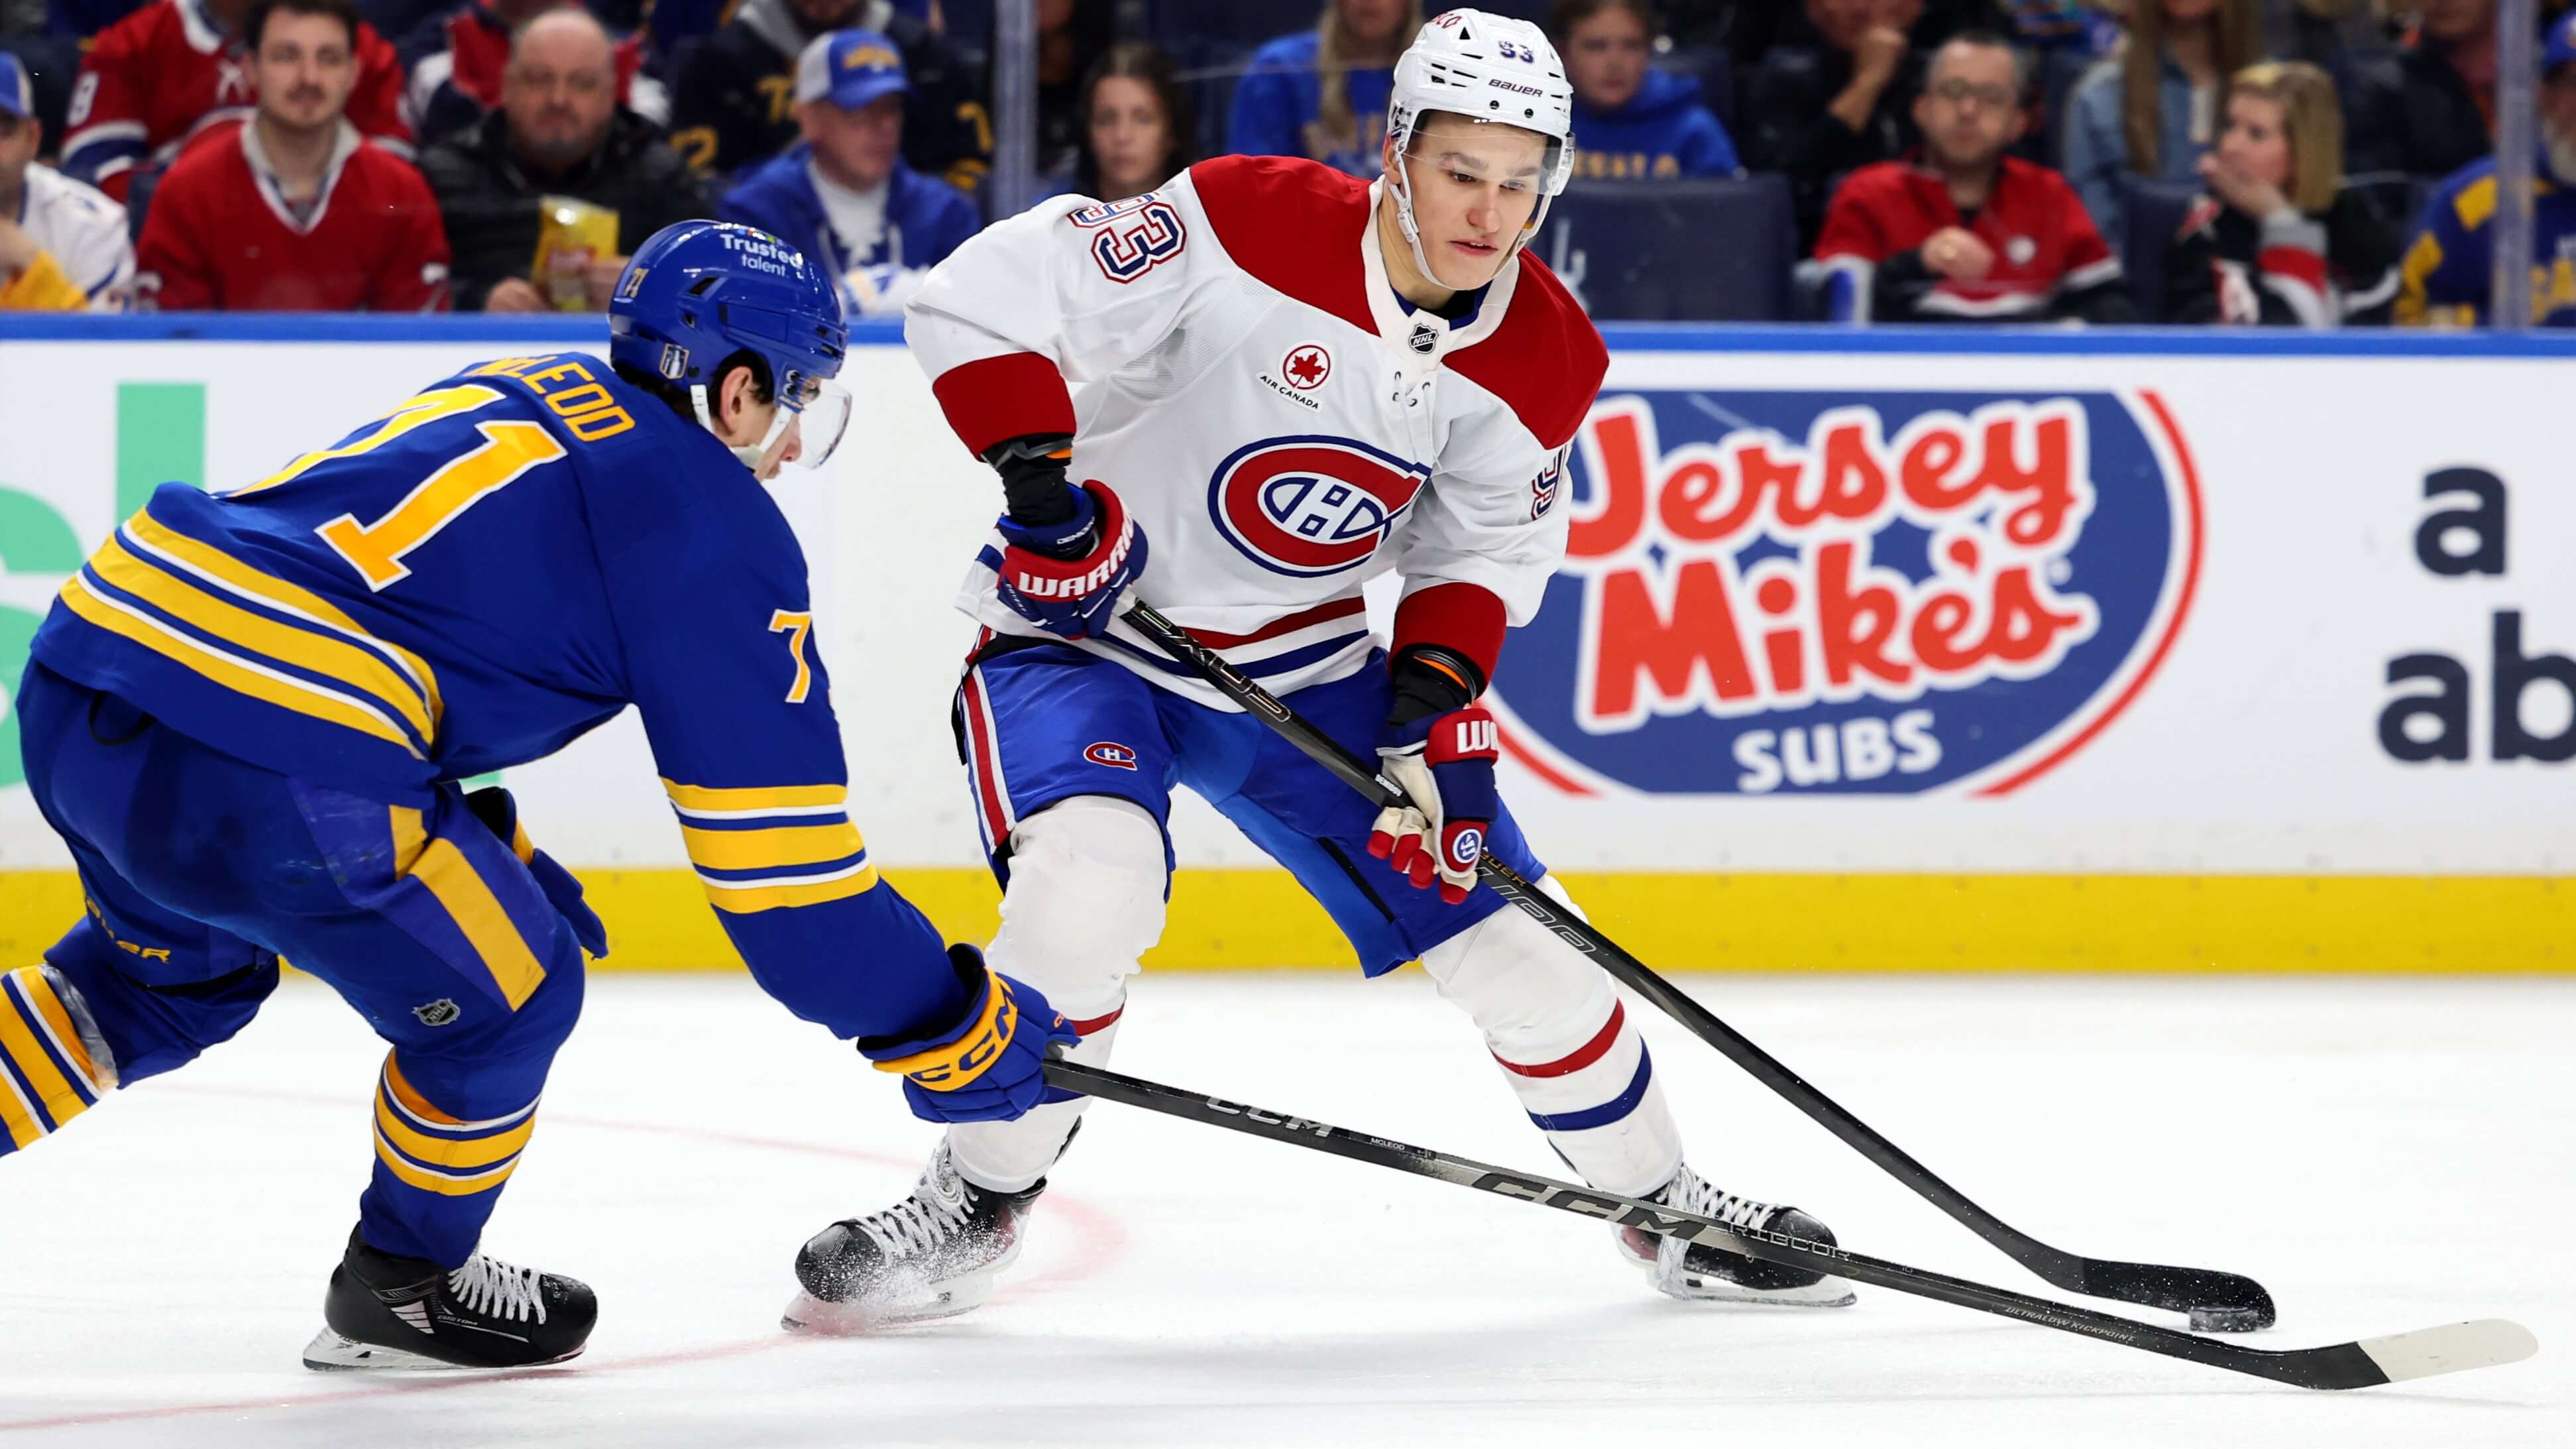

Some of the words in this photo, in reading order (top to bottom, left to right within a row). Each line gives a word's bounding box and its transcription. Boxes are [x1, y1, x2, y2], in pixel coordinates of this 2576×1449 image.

[1488, 78, 1543, 97] BAUER
[720, 233, 804, 270] Trusted
[742, 253, 786, 276] talent
[1259, 375, 1278, 389] AIR
[1279, 386, 1319, 410] CANADA
[209, 383, 569, 593] 71
[1566, 410, 2080, 559] Jersey
[2414, 466, 2508, 577] a
[1018, 510, 1135, 598] WARRI
[1129, 600, 1292, 723] EXUS
[1592, 536, 2085, 719] Mike's
[2377, 610, 2576, 763] ab
[1732, 711, 1943, 794] SUBS
[1480, 849, 1527, 887] AUER
[1206, 1096, 1334, 1138] CCM
[1371, 1137, 1406, 1151] MCLEOD
[1470, 1172, 1707, 1241] CCM
